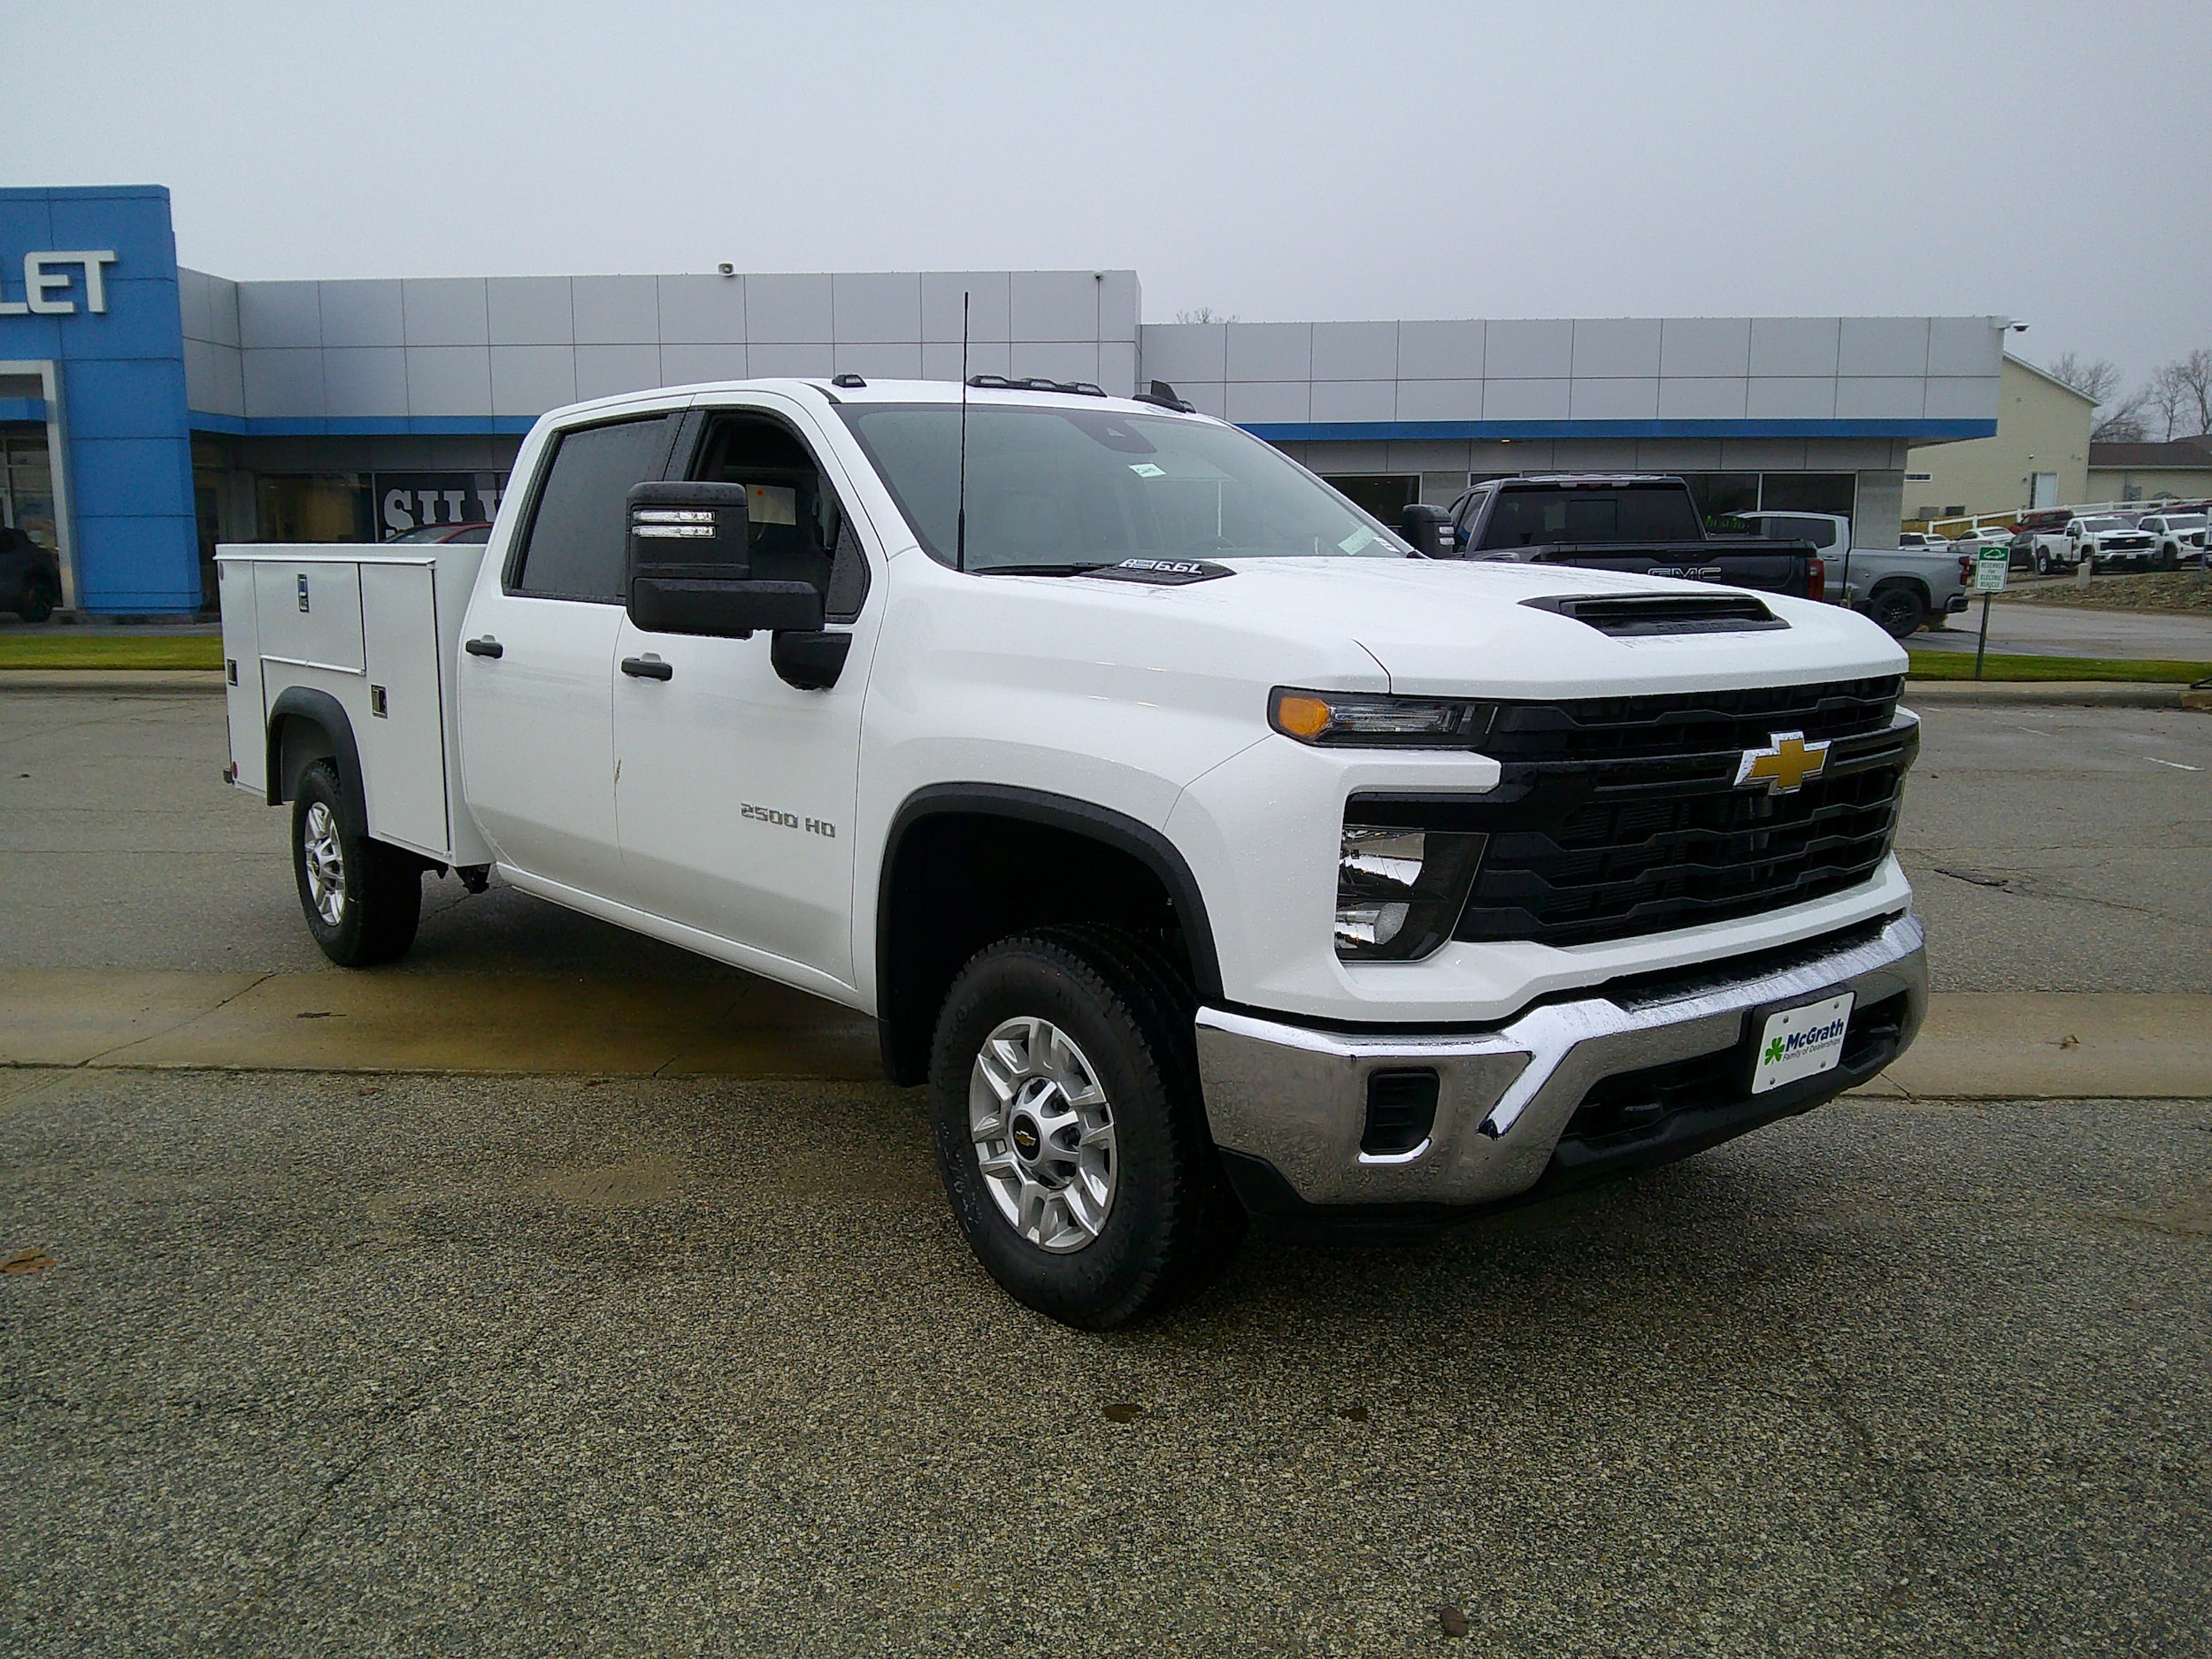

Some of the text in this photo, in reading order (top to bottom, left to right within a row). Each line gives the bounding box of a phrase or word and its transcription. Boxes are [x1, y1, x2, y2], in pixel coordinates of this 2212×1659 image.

[0, 250, 119, 314] ET
[1647, 567, 1721, 581] GMC
[1655, 621, 1746, 633] CHEVROLET
[741, 803, 835, 838] 2500 HD
[1782, 1037, 1841, 1062] Family of Dealerships
[1786, 1018, 1844, 1052] McGrath
